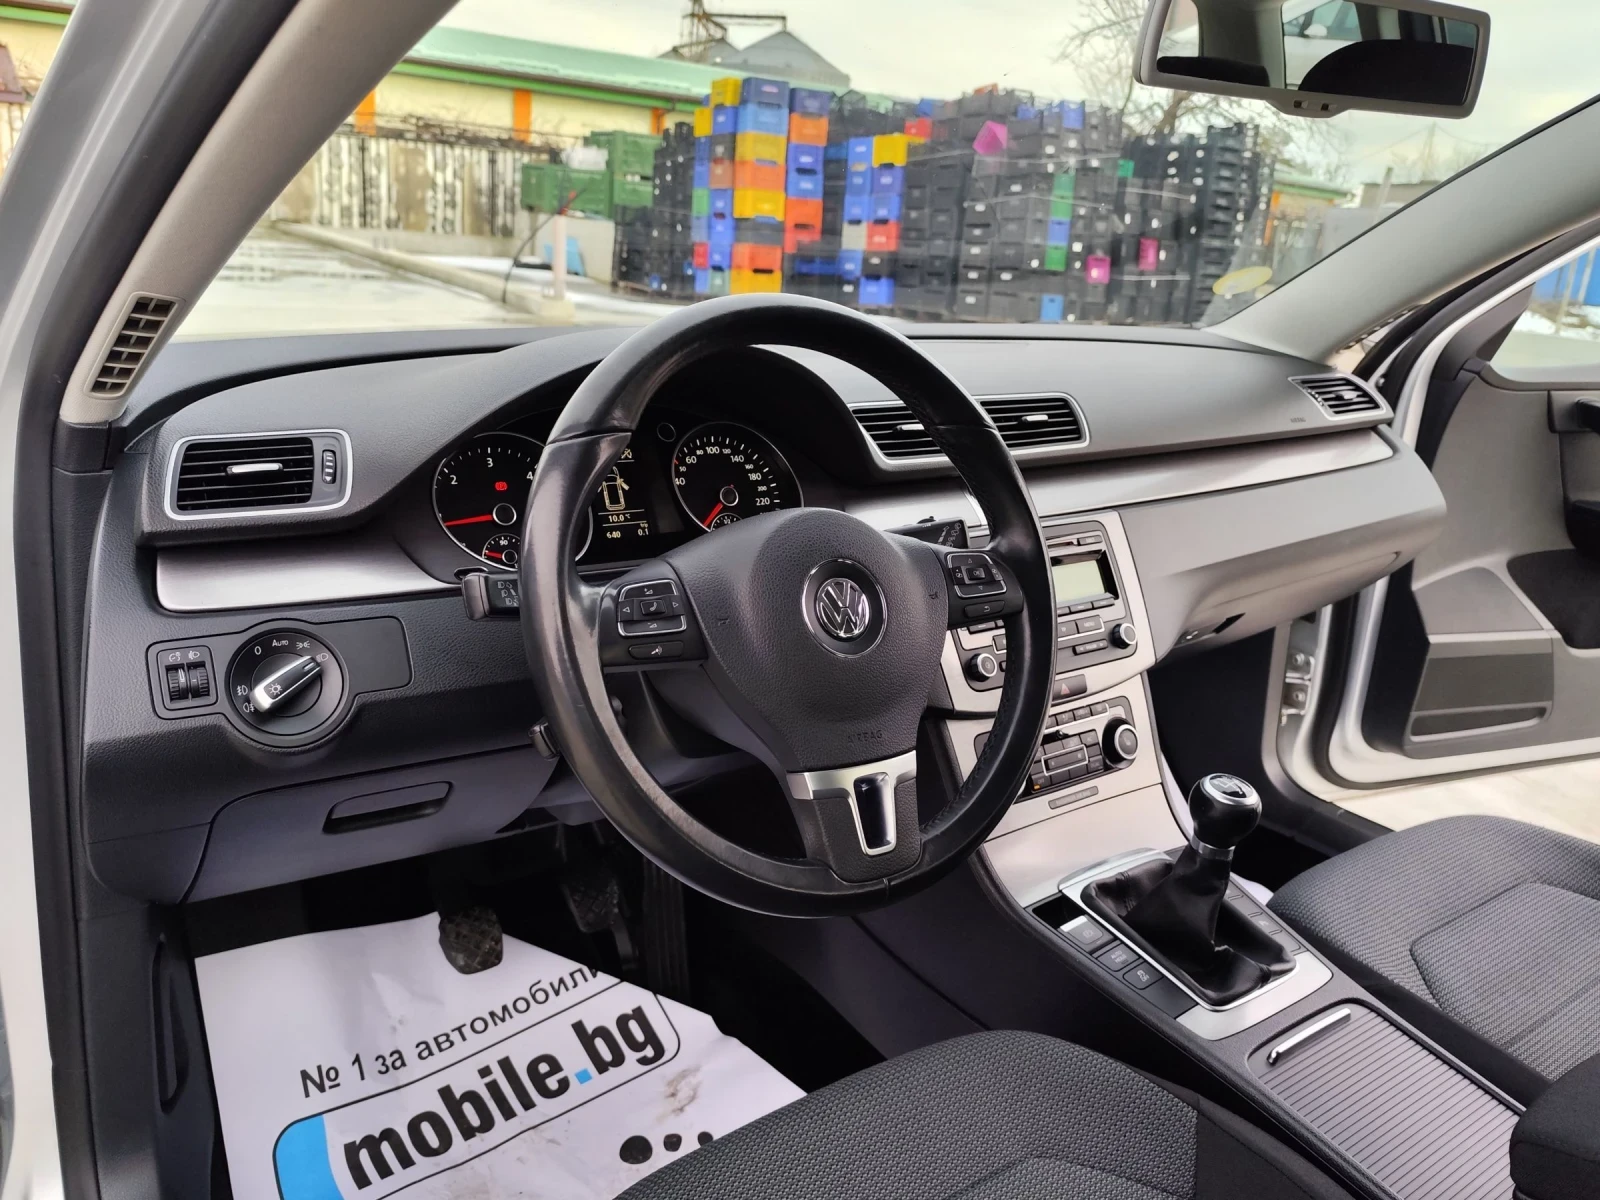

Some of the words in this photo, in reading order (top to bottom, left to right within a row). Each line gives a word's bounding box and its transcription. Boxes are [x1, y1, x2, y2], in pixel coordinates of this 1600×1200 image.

[706, 446, 720, 454] 100
[486, 457, 494, 468] 3
[685, 456, 697, 464] 60
[730, 455, 745, 463] 140
[449, 475, 458, 485] 2
[526, 471, 534, 480] 4
[748, 472, 762, 481] 180
[675, 477, 686, 485] 40
[755, 497, 770, 506] 220
[608, 514, 625, 523] 10.0
[606, 531, 621, 539] 640
[637, 528, 649, 536] 0.1
[350, 1051, 367, 1082] 1
[375, 1048, 408, 1076] за
[343, 1005, 667, 1191] mobile.bg
